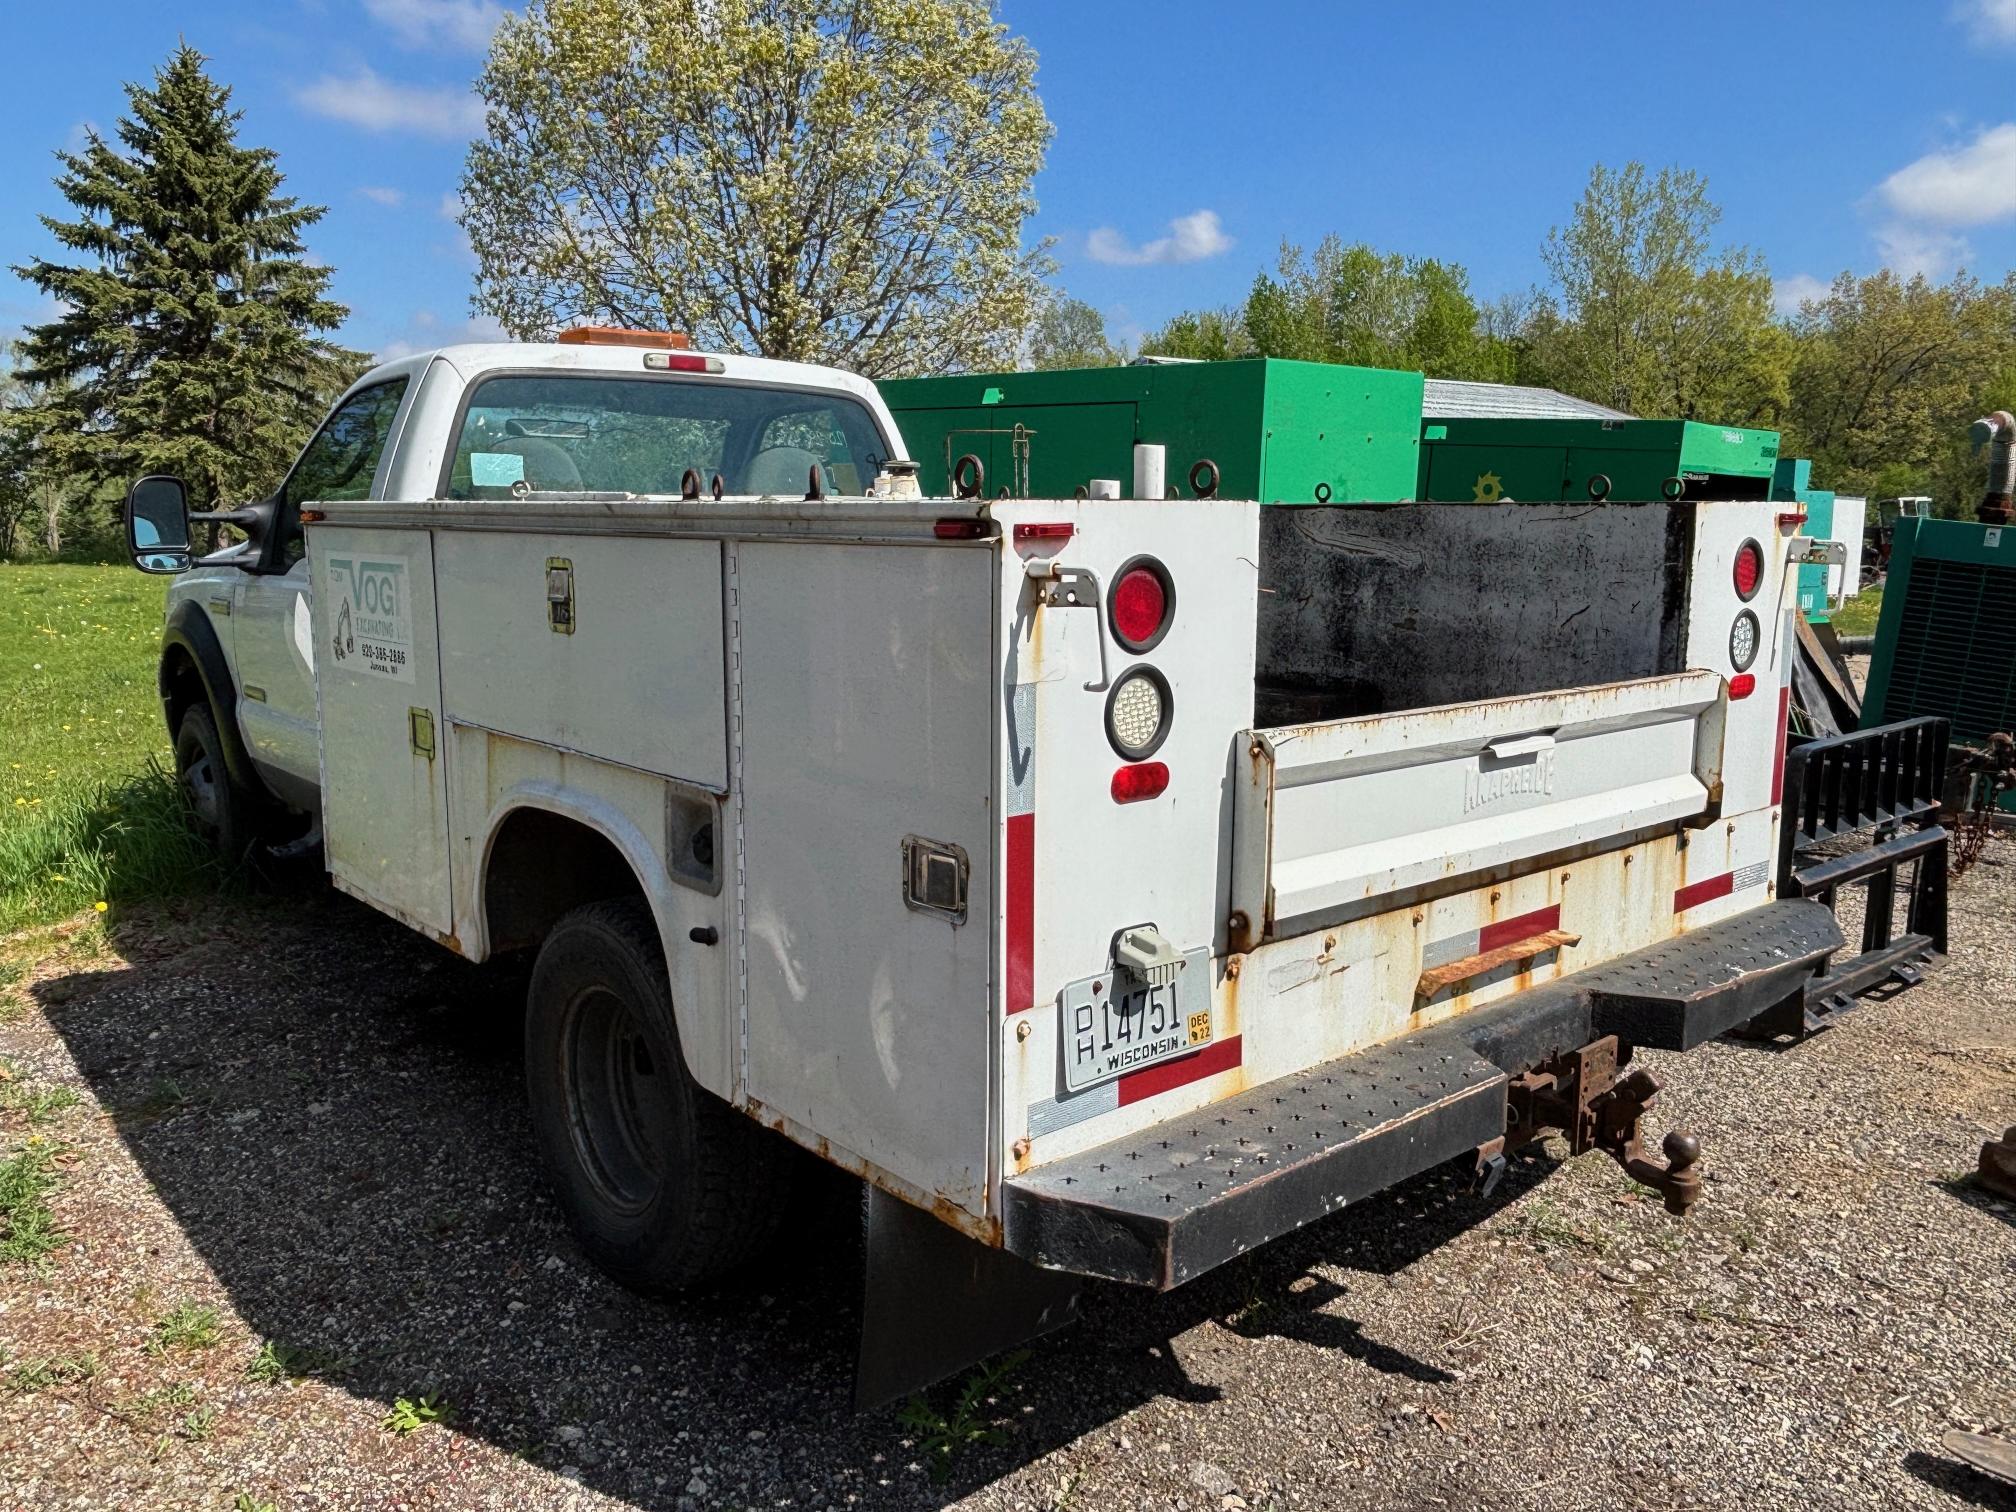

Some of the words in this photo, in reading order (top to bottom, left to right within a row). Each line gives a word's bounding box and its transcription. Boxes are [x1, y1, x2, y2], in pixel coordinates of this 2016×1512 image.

[1101, 981, 1181, 1051] 14751
[1190, 1012, 1209, 1028] DEC
[1199, 1025, 1211, 1040] 22
[1106, 1035, 1179, 1071] WISCONSIN
